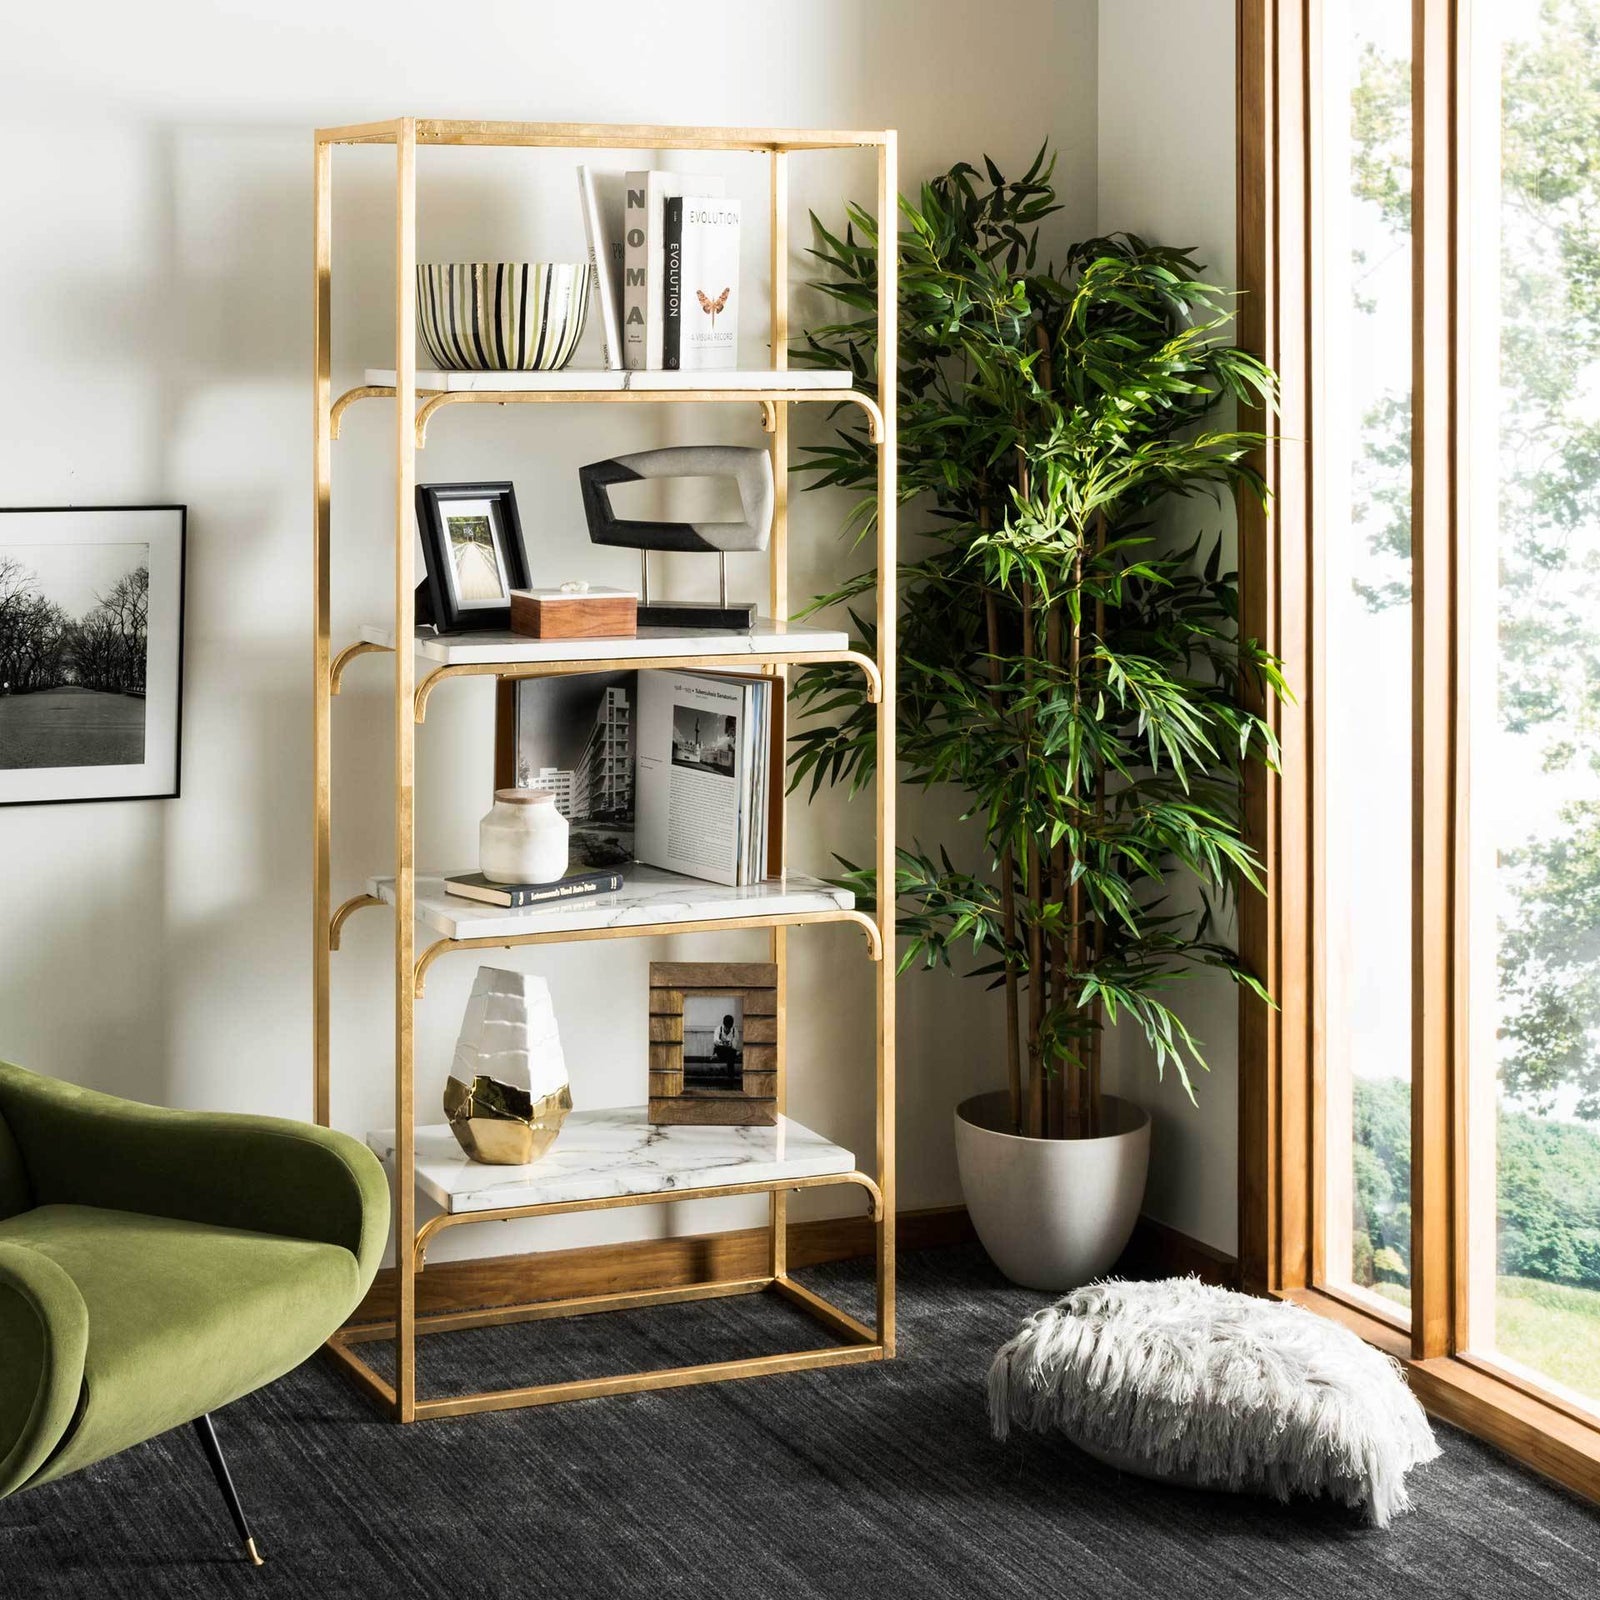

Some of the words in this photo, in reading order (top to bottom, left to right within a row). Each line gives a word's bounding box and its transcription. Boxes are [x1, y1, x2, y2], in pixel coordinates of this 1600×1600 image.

[690, 211, 739, 225] EVOLUTION
[626, 189, 646, 325] NOMA
[669, 243, 679, 317] EVOLUTION
